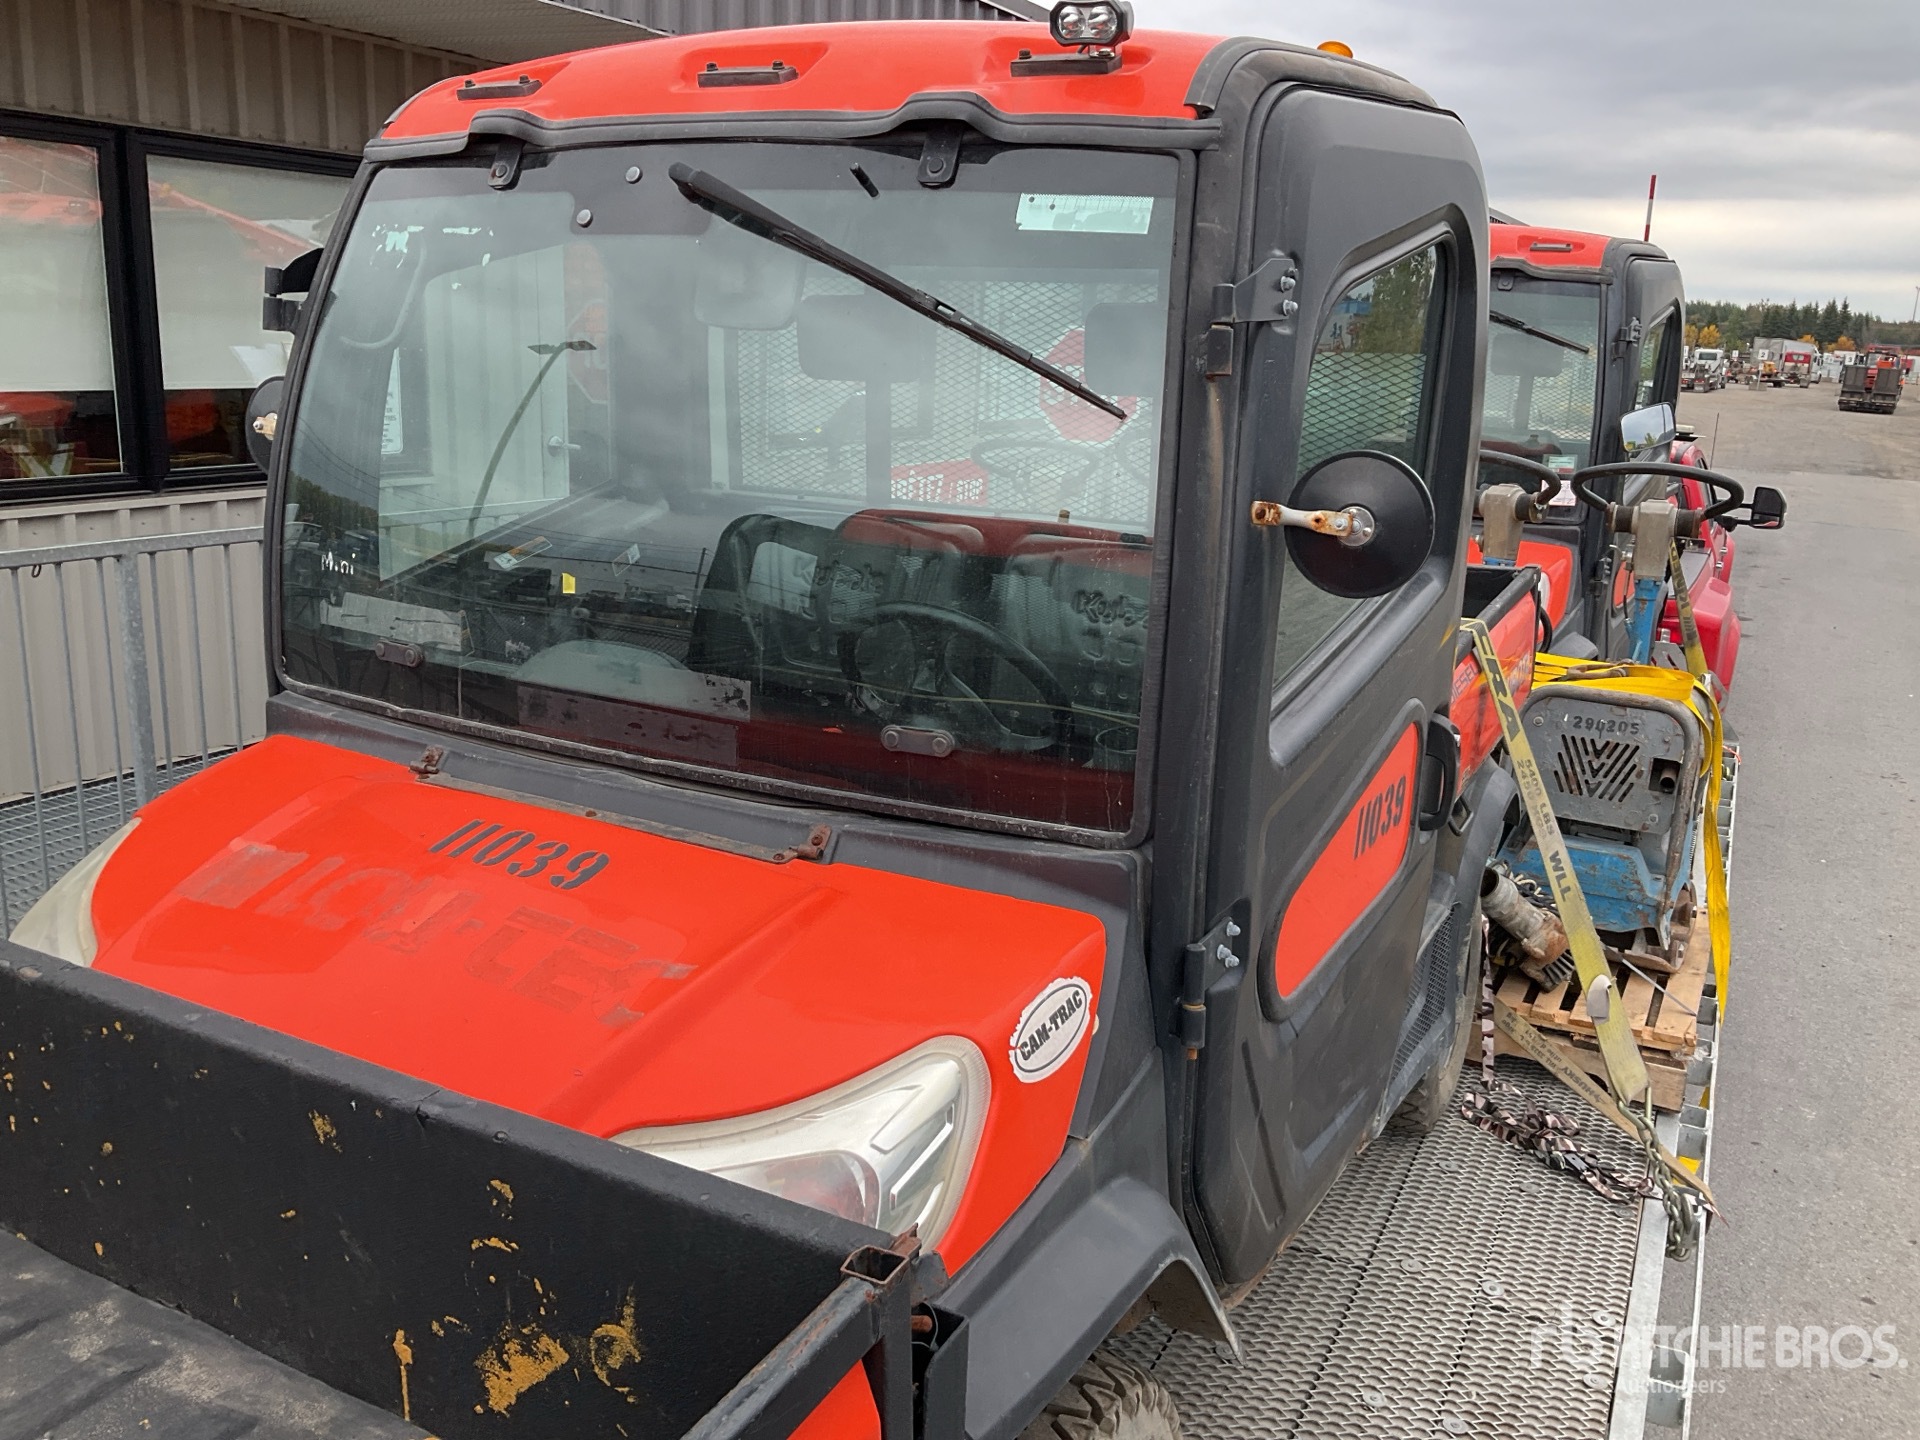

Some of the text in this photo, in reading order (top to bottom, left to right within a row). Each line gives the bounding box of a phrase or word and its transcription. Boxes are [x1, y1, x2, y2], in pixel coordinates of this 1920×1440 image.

[321, 551, 356, 575] Mini
[1572, 715, 1640, 739] 290205
[1353, 775, 1406, 860] 11039
[429, 819, 610, 891] 11039
[1549, 850, 1571, 902] WLL
[1020, 990, 1083, 1061] CAM-TRAC
